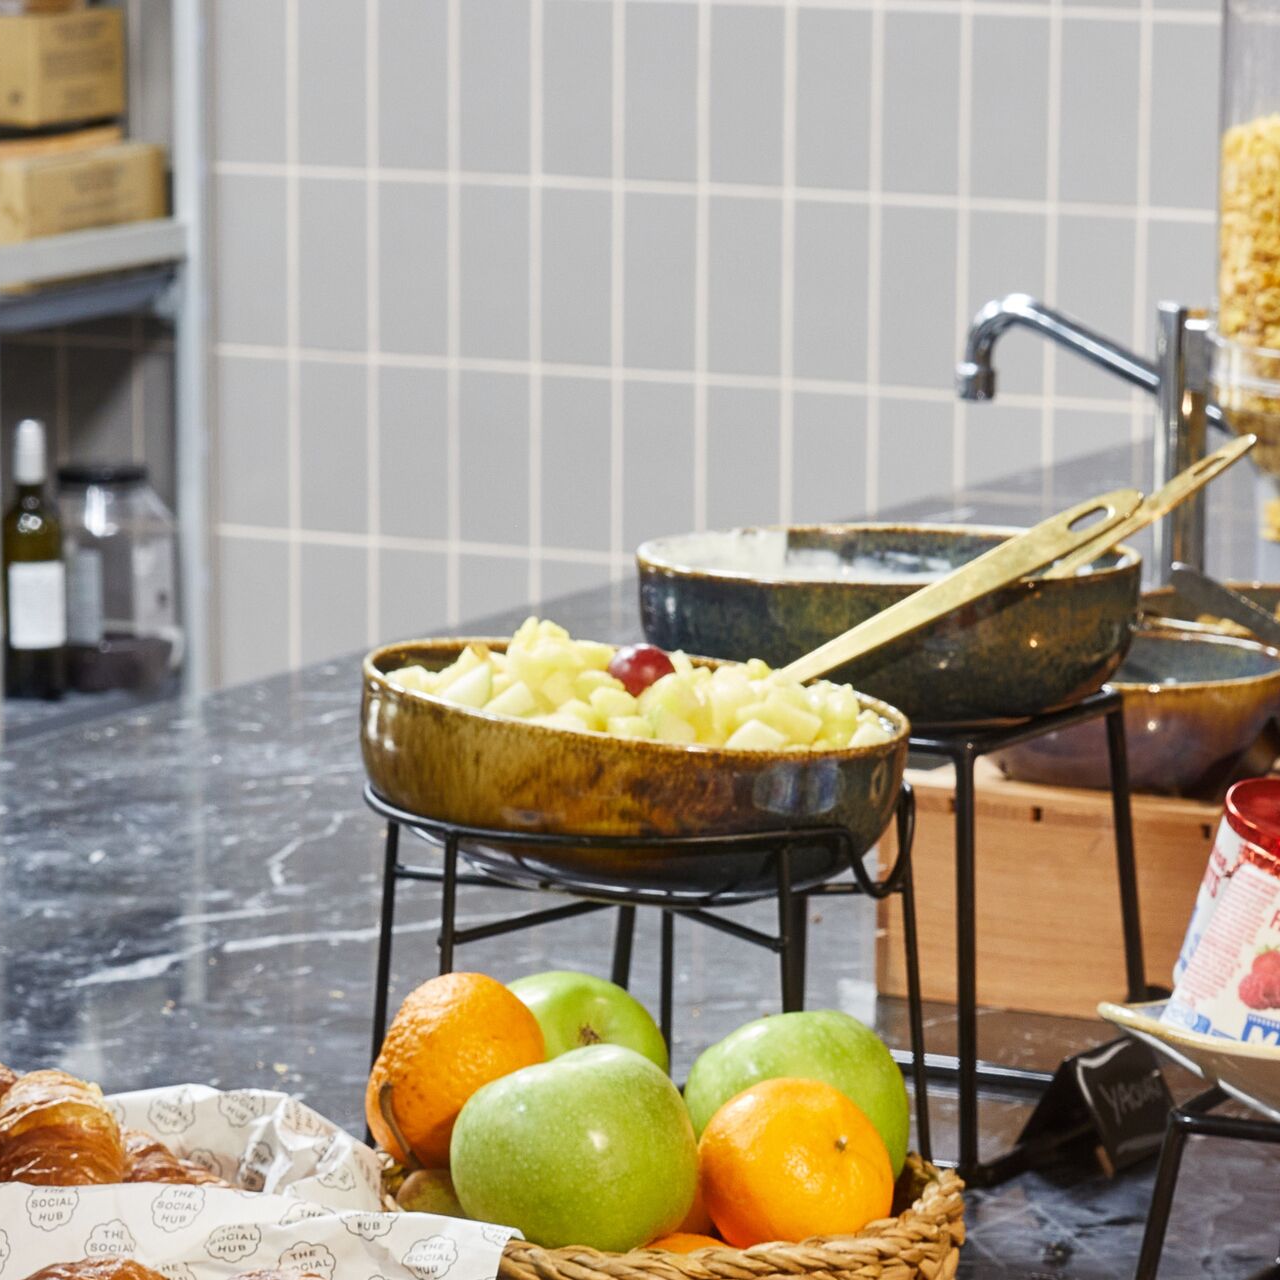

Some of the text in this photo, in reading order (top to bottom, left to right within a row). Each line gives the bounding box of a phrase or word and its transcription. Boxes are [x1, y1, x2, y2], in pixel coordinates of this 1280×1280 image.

[172, 1189, 195, 1199] THE
[31, 1198, 75, 1209] SOCIAL
[156, 1200, 199, 1212] SOCIAL
[38, 1211, 64, 1222] HUB
[160, 1213, 187, 1224] HUB
[290, 1249, 317, 1261] THE
